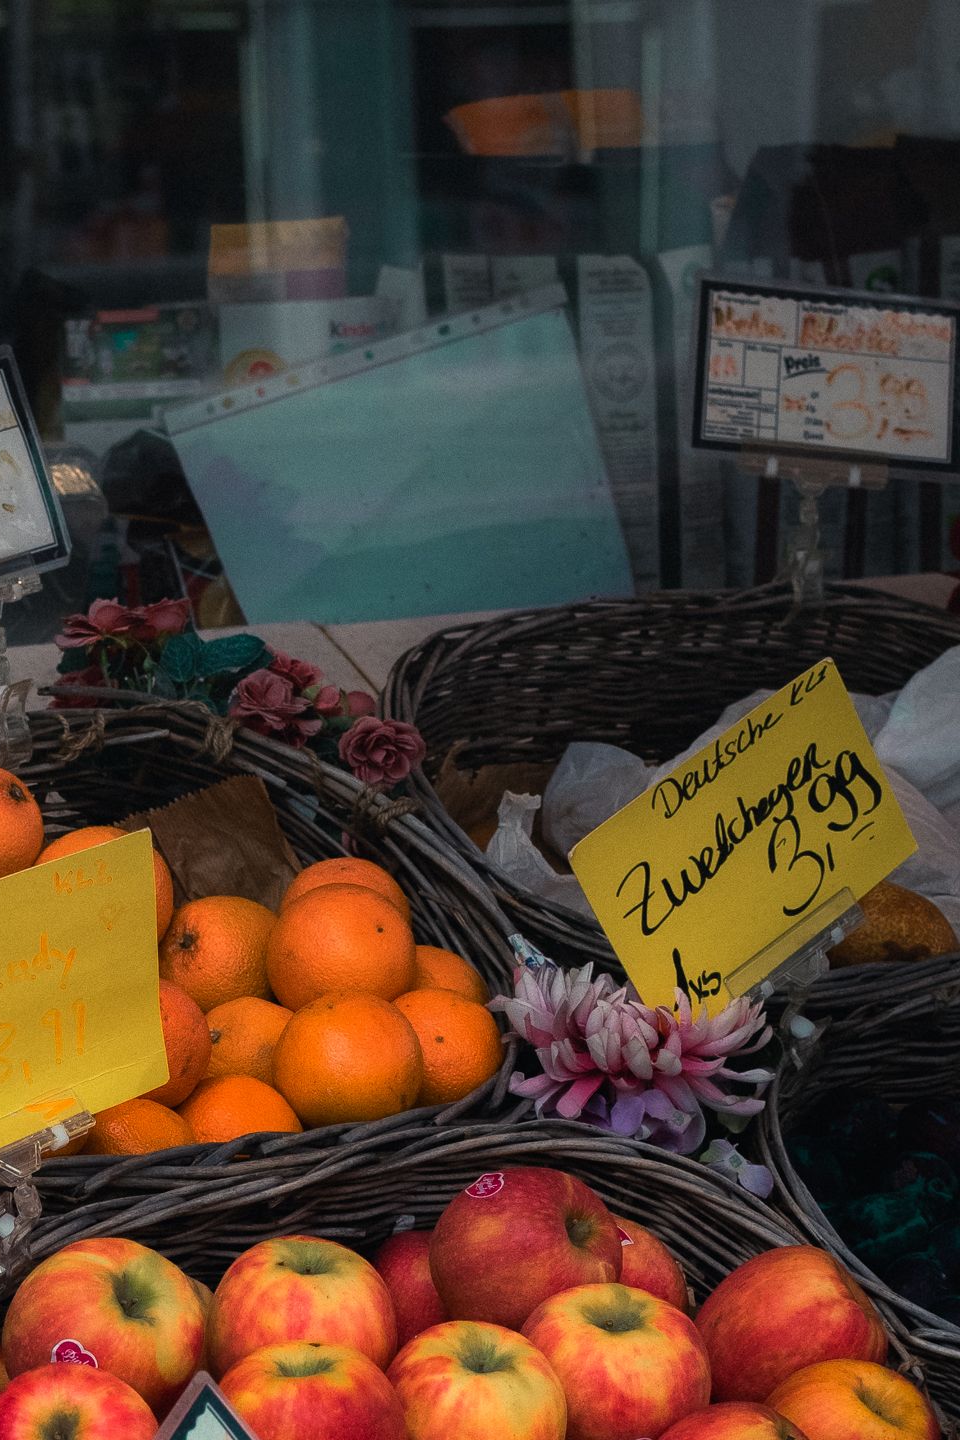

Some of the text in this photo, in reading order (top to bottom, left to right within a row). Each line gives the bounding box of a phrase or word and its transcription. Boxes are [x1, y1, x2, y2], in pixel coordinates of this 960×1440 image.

[784, 353, 821, 374] Preis
[651, 711, 784, 819] Deutsche
[768, 750, 883, 917] 3,99
